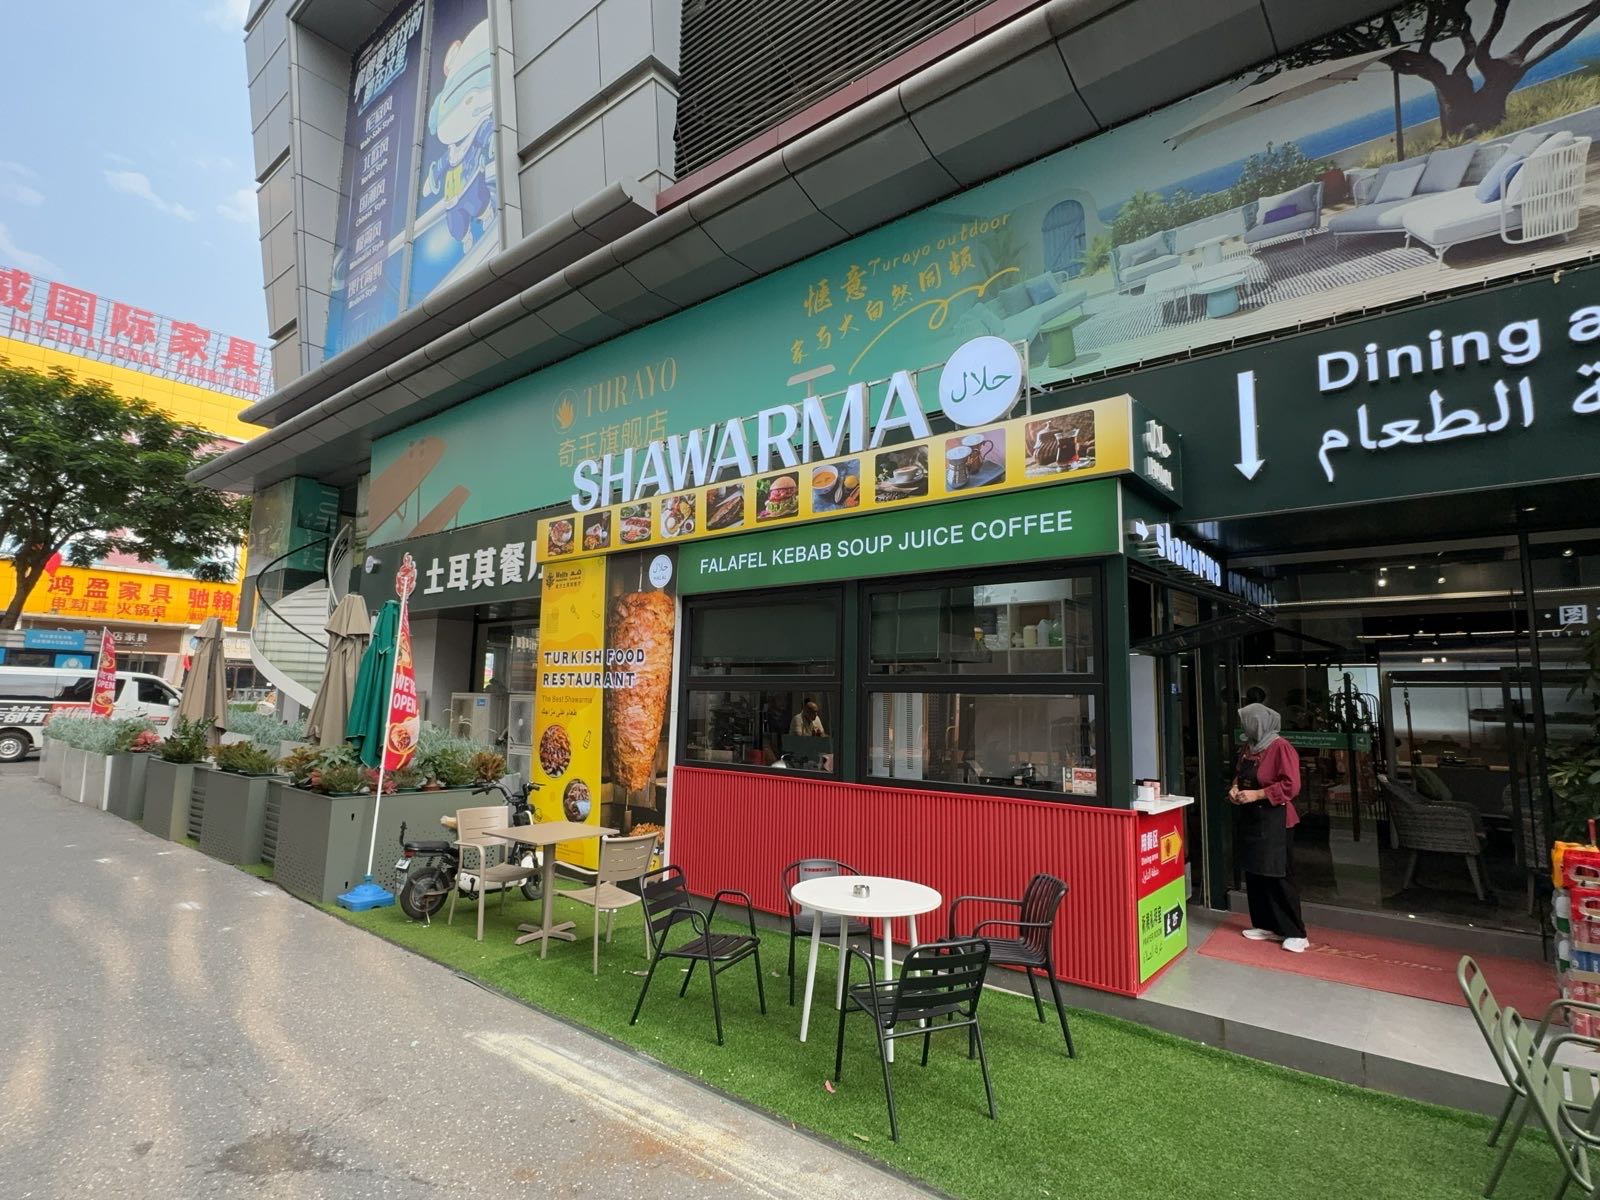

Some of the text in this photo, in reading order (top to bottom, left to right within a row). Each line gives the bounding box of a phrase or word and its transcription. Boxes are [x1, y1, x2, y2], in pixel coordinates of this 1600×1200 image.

[936, 213, 1010, 250] outdoor
[11, 315, 161, 368] INTERNATIONAL
[1318, 319, 1541, 392] Dining
[584, 356, 677, 417] TURAYO
[951, 366, 1012, 404] حلال
[571, 370, 932, 512] SHAWARMA
[1318, 376, 1535, 483] الطعام
[700, 510, 1073, 575] FALAFEL KEBAB SOUP JUICE COFFEE
[188, 588, 240, 612] 驰翰
[542, 671, 636, 688] RESTAURANT
[544, 648, 646, 666] TURKISH FOOD
[393, 692, 417, 715] OPEN
